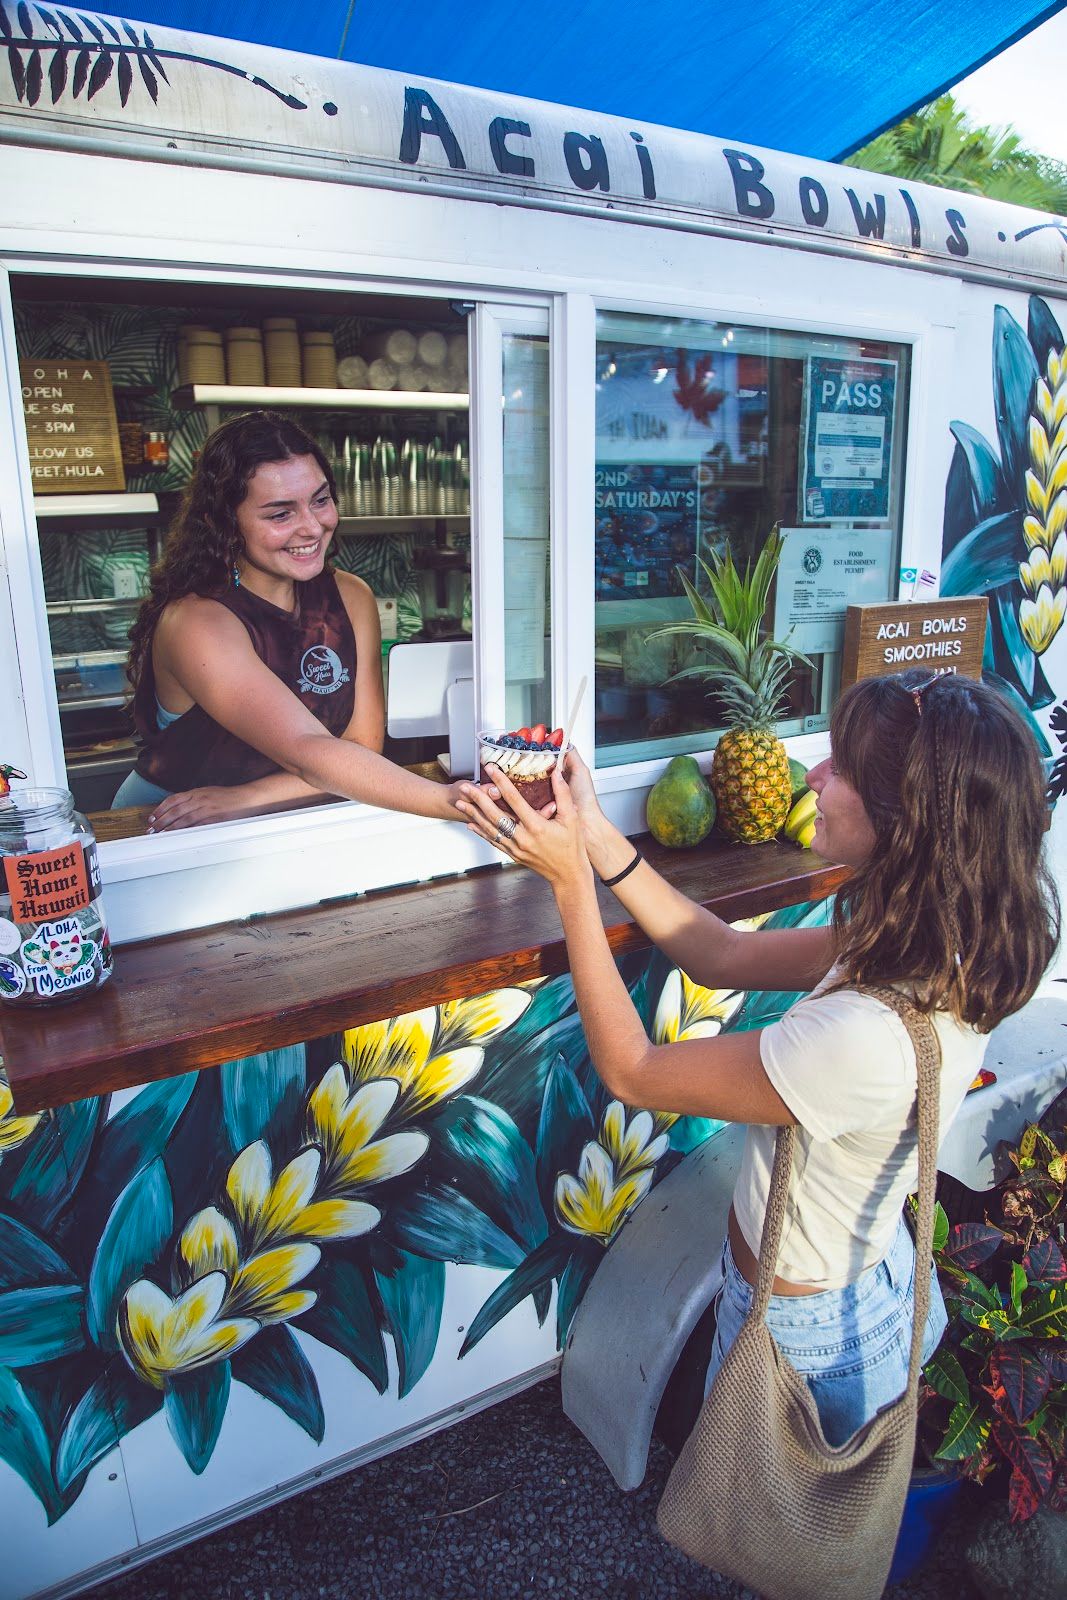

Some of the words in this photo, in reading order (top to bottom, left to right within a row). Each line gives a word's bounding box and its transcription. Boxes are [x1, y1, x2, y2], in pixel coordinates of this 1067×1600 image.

[398, 86, 657, 200] Acai
[722, 148, 969, 257] Bowls
[22, 387, 63, 398] OPEN
[821, 380, 882, 409] PASS
[51, 403, 75, 414] SAT
[45, 422, 75, 433] 3PM
[75, 447, 94, 458] US
[595, 471, 628, 487] 2ND
[595, 491, 695, 508] SATURDAY'S
[876, 622, 910, 640] ACAI
[922, 617, 967, 636] BOWLS
[884, 640, 962, 663] SMOOTHIES
[306, 663, 331, 678] Sweet
[16, 851, 77, 879] Sweet
[20, 874, 78, 898] Home
[16, 889, 87, 919] Hawaii
[35, 920, 78, 944] ALOHA
[27, 965, 48, 975] from
[39, 968, 93, 992] Meowie
